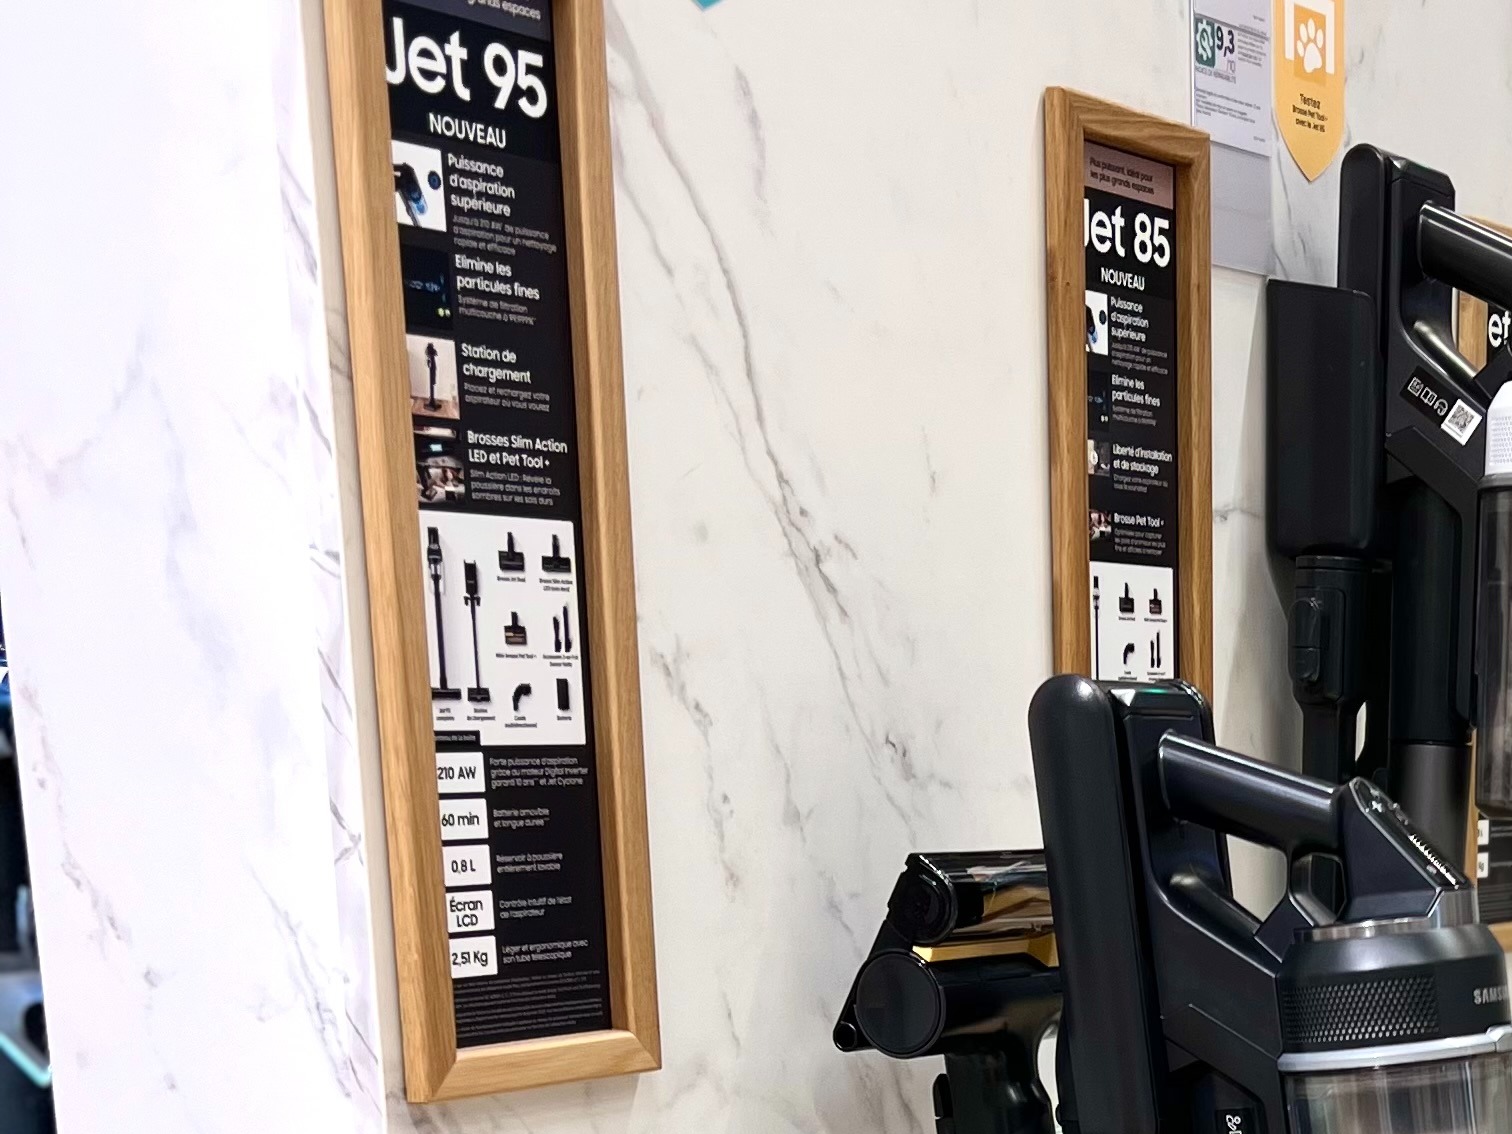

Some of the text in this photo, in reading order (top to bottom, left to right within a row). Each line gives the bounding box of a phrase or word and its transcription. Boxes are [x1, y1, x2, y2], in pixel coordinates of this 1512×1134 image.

[1216, 26, 1235, 58] 9,3
[385, 16, 548, 118] Jet 95
[429, 112, 506, 149] NOUVEAU
[447, 153, 504, 178] Puissance
[449, 174, 516, 199] d'aspiration
[1133, 212, 1171, 268] 85
[495, 261, 512, 278] les
[1100, 267, 1146, 291] NOUVEAU
[457, 275, 540, 300] particules fines
[1110, 296, 1143, 313] Puissance
[1488, 310, 1511, 348] et
[461, 343, 517, 364] Station de
[463, 363, 532, 384] chargement
[1135, 379, 1145, 390] les
[1111, 390, 1161, 407] particules fines
[467, 430, 568, 454] Brosses Slim Action
[468, 449, 488, 464] LED
[489, 452, 501, 465] et
[502, 453, 520, 467] Pet
[522, 454, 544, 469] Tool
[1112, 443, 1173, 462] Liberté d'installation
[1113, 459, 1159, 477] et de stockage
[1113, 512, 1136, 526] Brosse
[1136, 514, 1147, 527] Pet
[437, 766, 477, 780] 210 AW
[441, 812, 480, 827] 60 min
[451, 859, 476, 874] 0,8 L
[449, 897, 484, 912] Écran
[456, 914, 479, 928] LCD
[451, 951, 488, 967] 2,51 Kg
[1473, 985, 1508, 1005] SAMS
